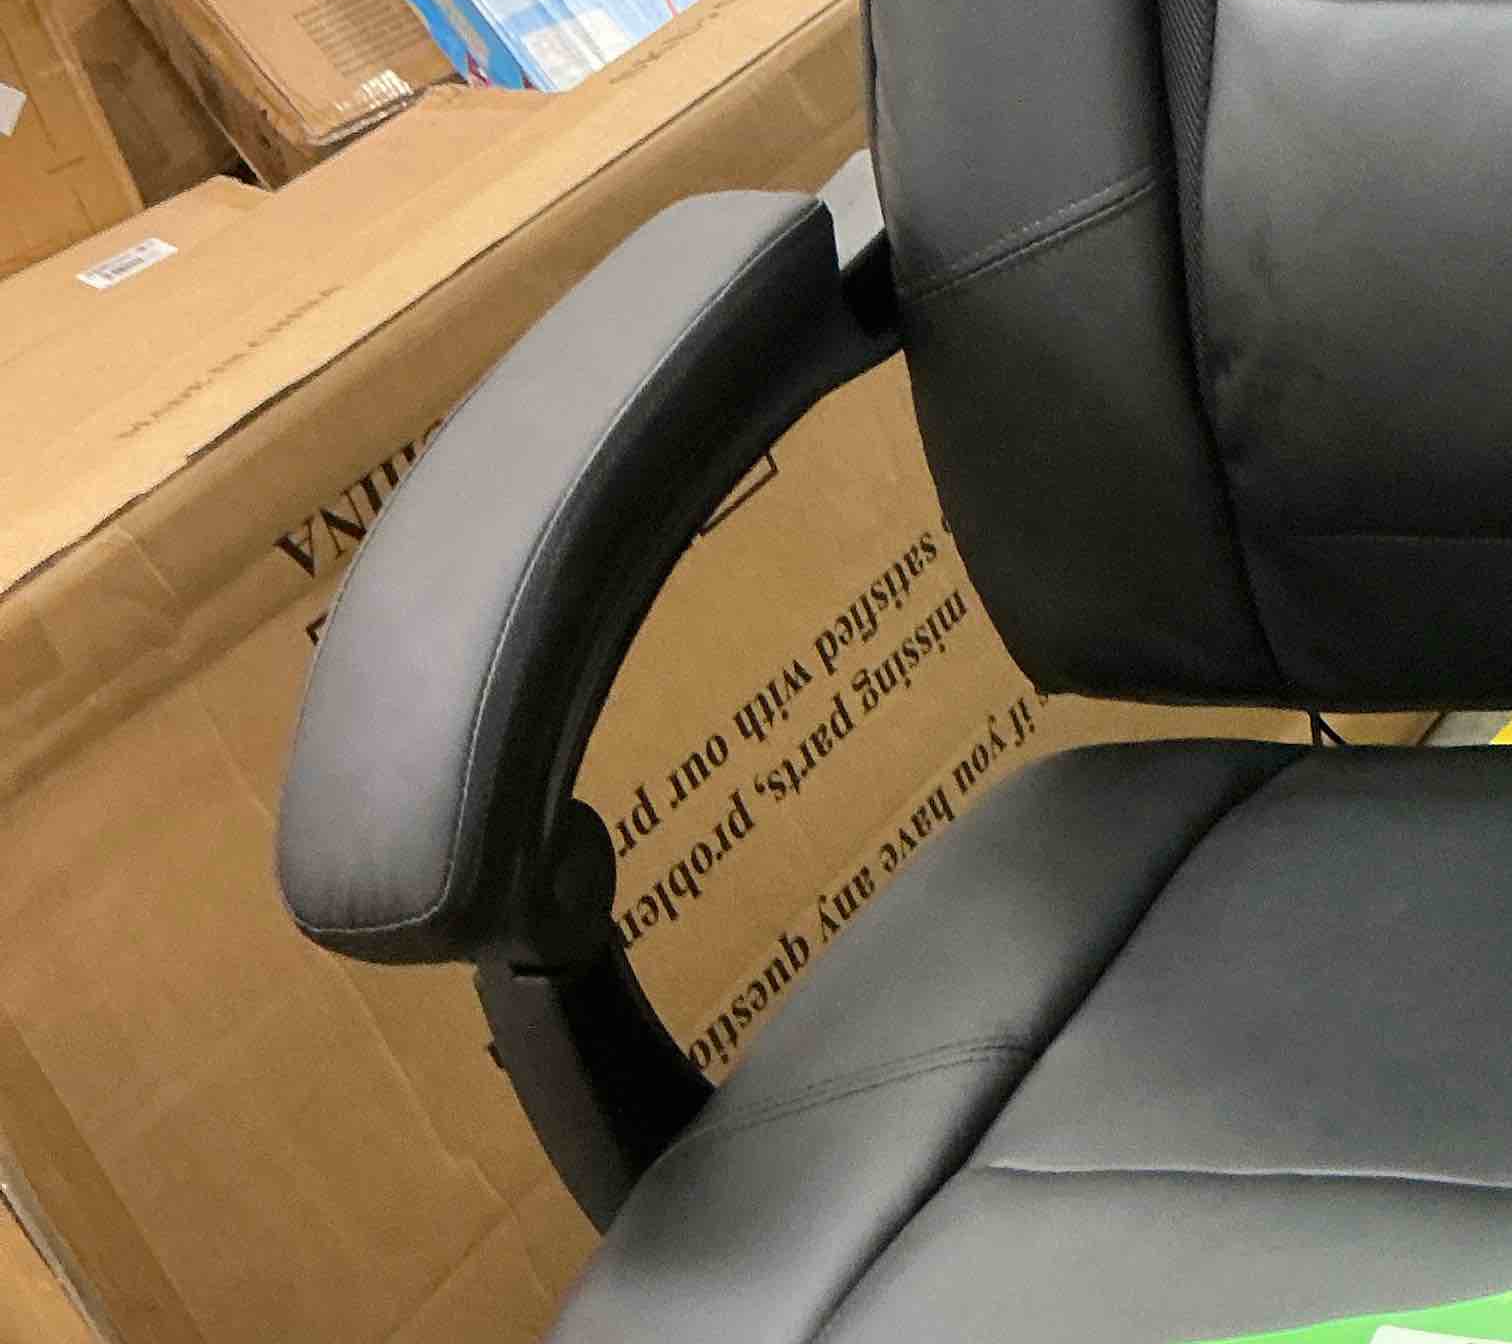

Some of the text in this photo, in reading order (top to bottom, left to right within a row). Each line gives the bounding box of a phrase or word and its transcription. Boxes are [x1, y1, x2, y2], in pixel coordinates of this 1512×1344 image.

[273, 416, 443, 580] INA
[613, 532, 939, 859] satisfied with our pr
[850, 589, 969, 716] missing
[753, 693, 856, 806] parts,
[686, 696, 1036, 1074] if you have any questio
